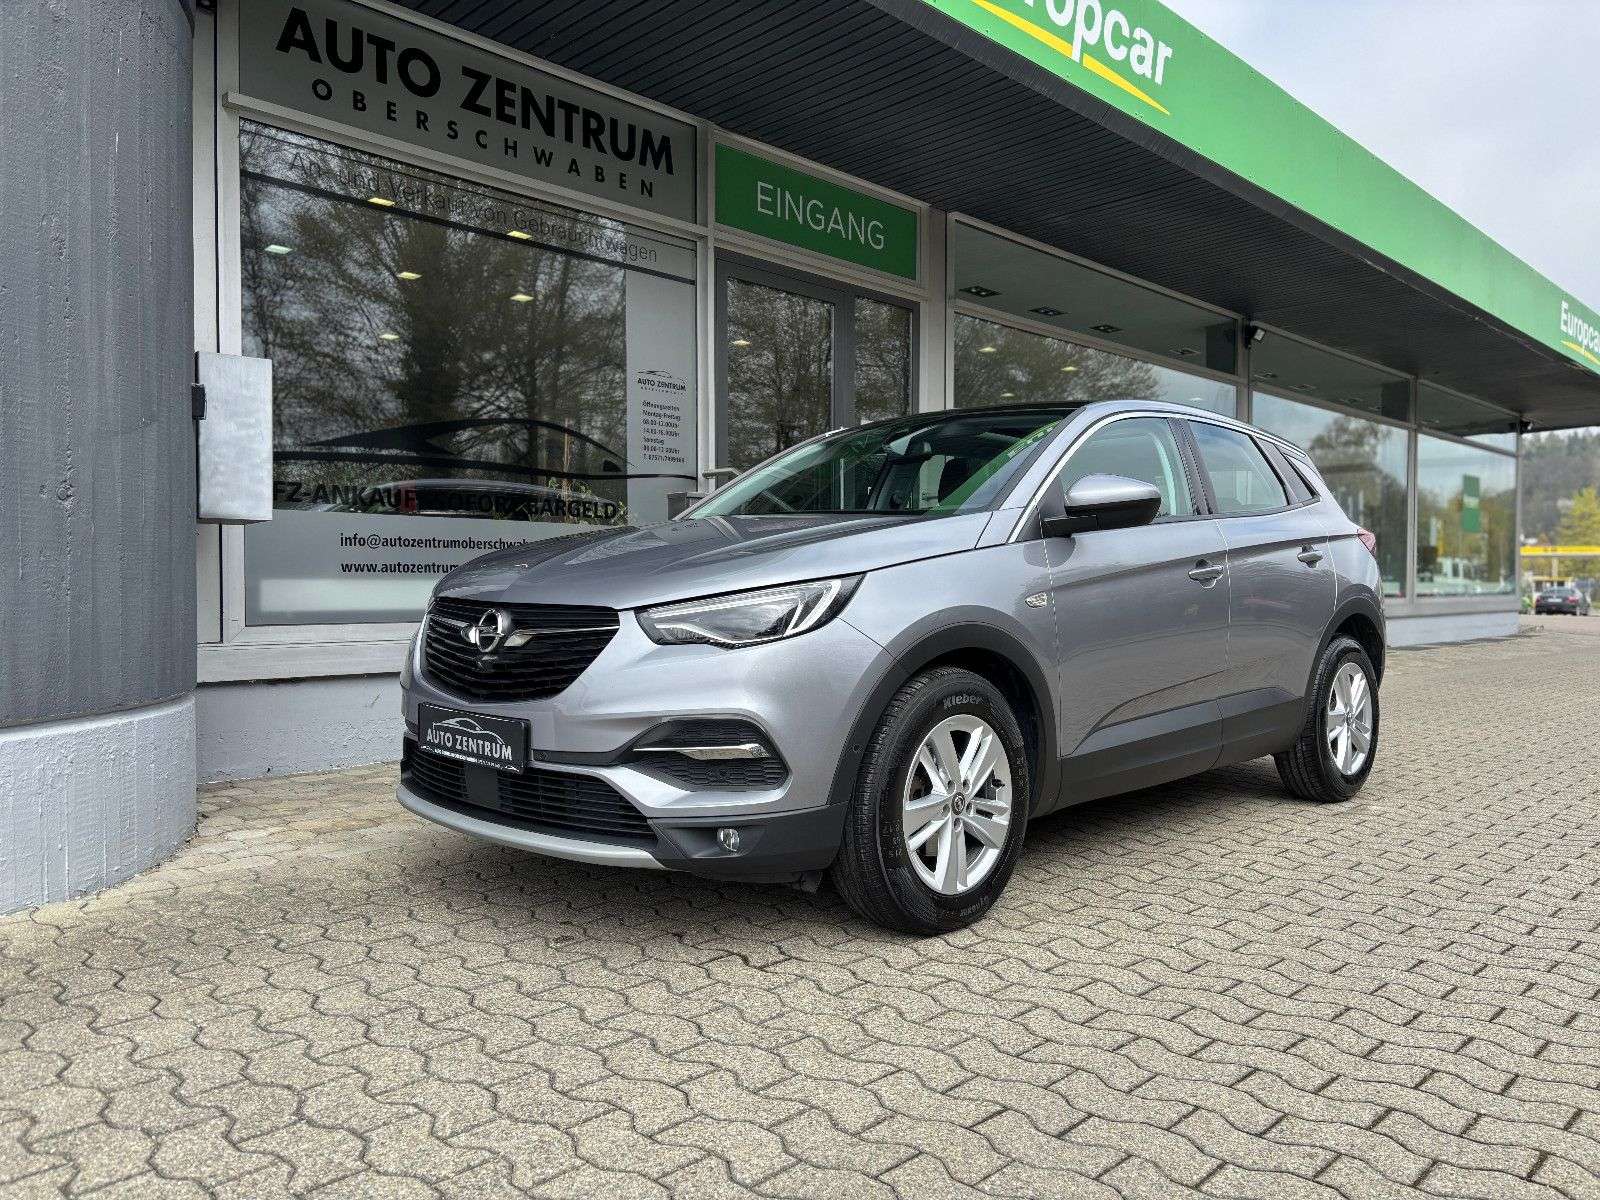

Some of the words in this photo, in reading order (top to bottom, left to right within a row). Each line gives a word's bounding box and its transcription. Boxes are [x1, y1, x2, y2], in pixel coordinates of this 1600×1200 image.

[1024, 0, 1174, 86] opcar
[275, 6, 442, 98] AUTO
[458, 65, 675, 176] ZENTRUM
[311, 79, 653, 198] OBERSCHWABEN
[757, 180, 886, 250] EINGANG
[637, 377, 656, 387] AUTO
[656, 380, 686, 391] ZENTRUM
[339, 532, 528, 550] info@autozentrumoberschw
[426, 728, 453, 748] AUTO
[455, 735, 513, 761] ZENTRUM
